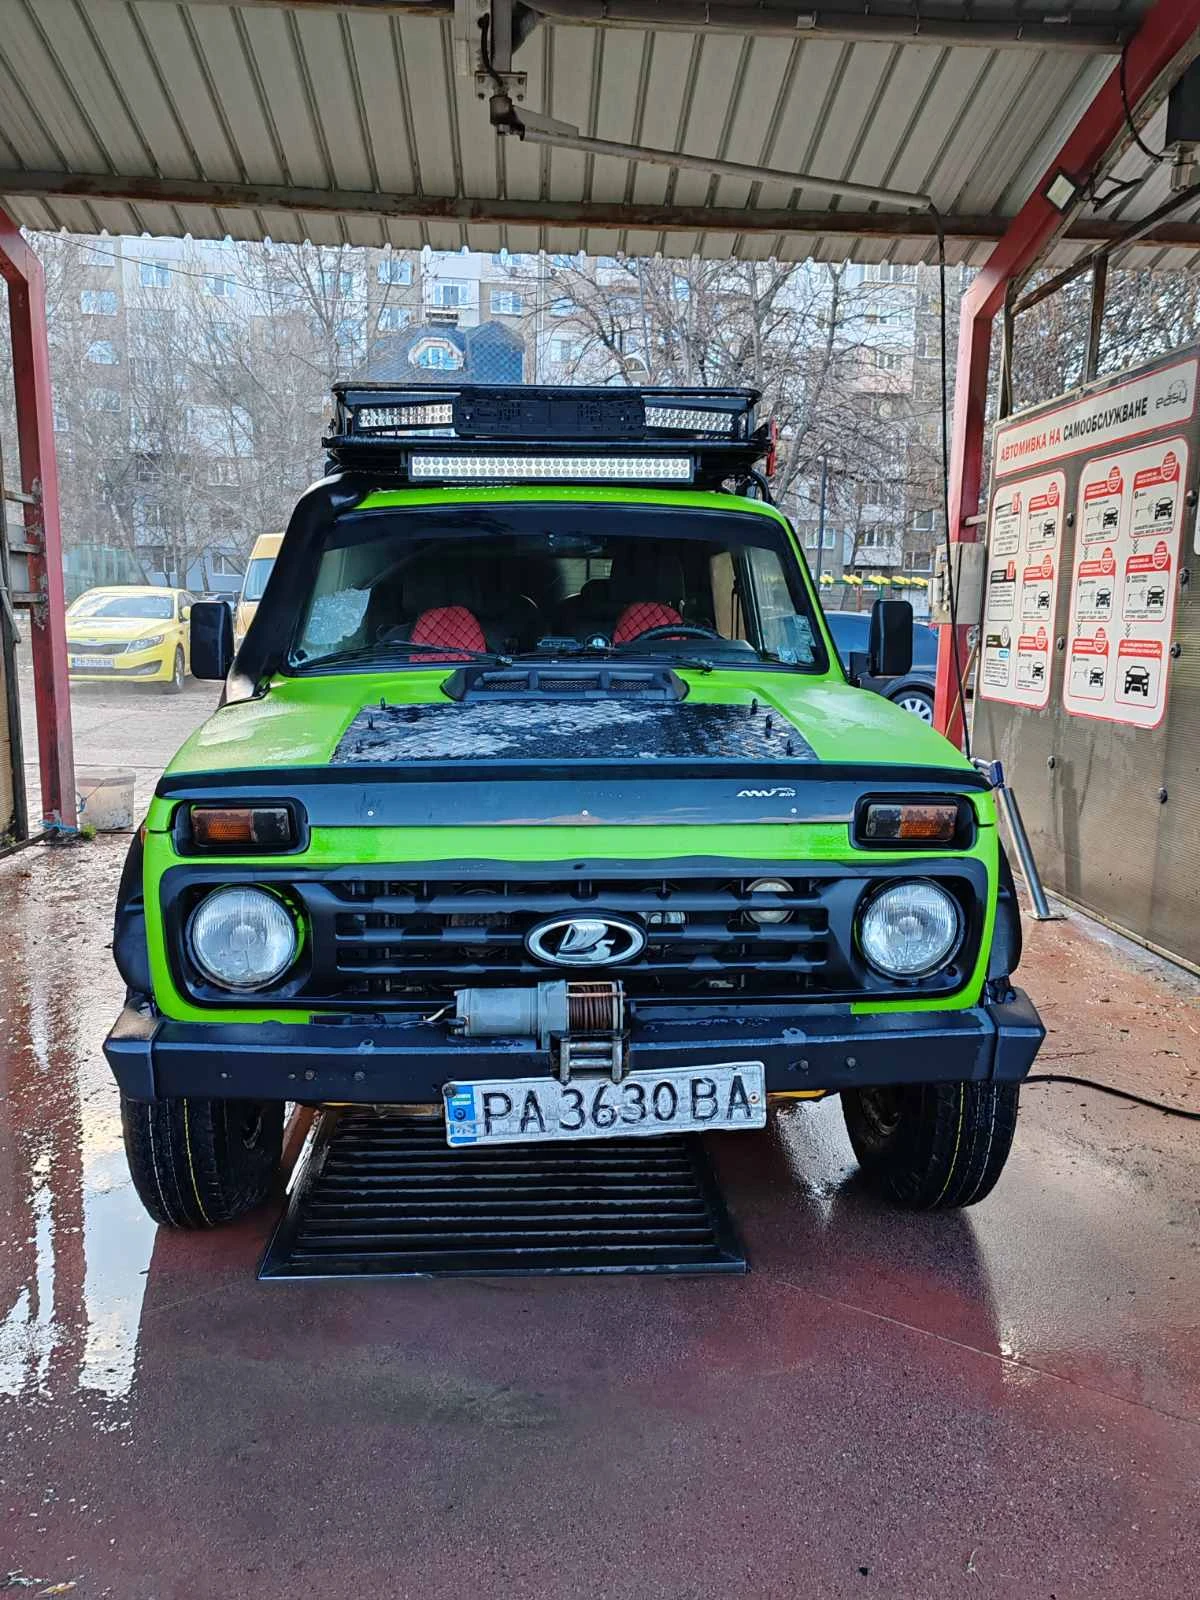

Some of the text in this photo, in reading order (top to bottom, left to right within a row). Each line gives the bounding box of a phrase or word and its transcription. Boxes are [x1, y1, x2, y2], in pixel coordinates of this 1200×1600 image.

[1001, 397, 1148, 461] АВТОМИВКА НА САМООБСЛУЖВАНЕ
